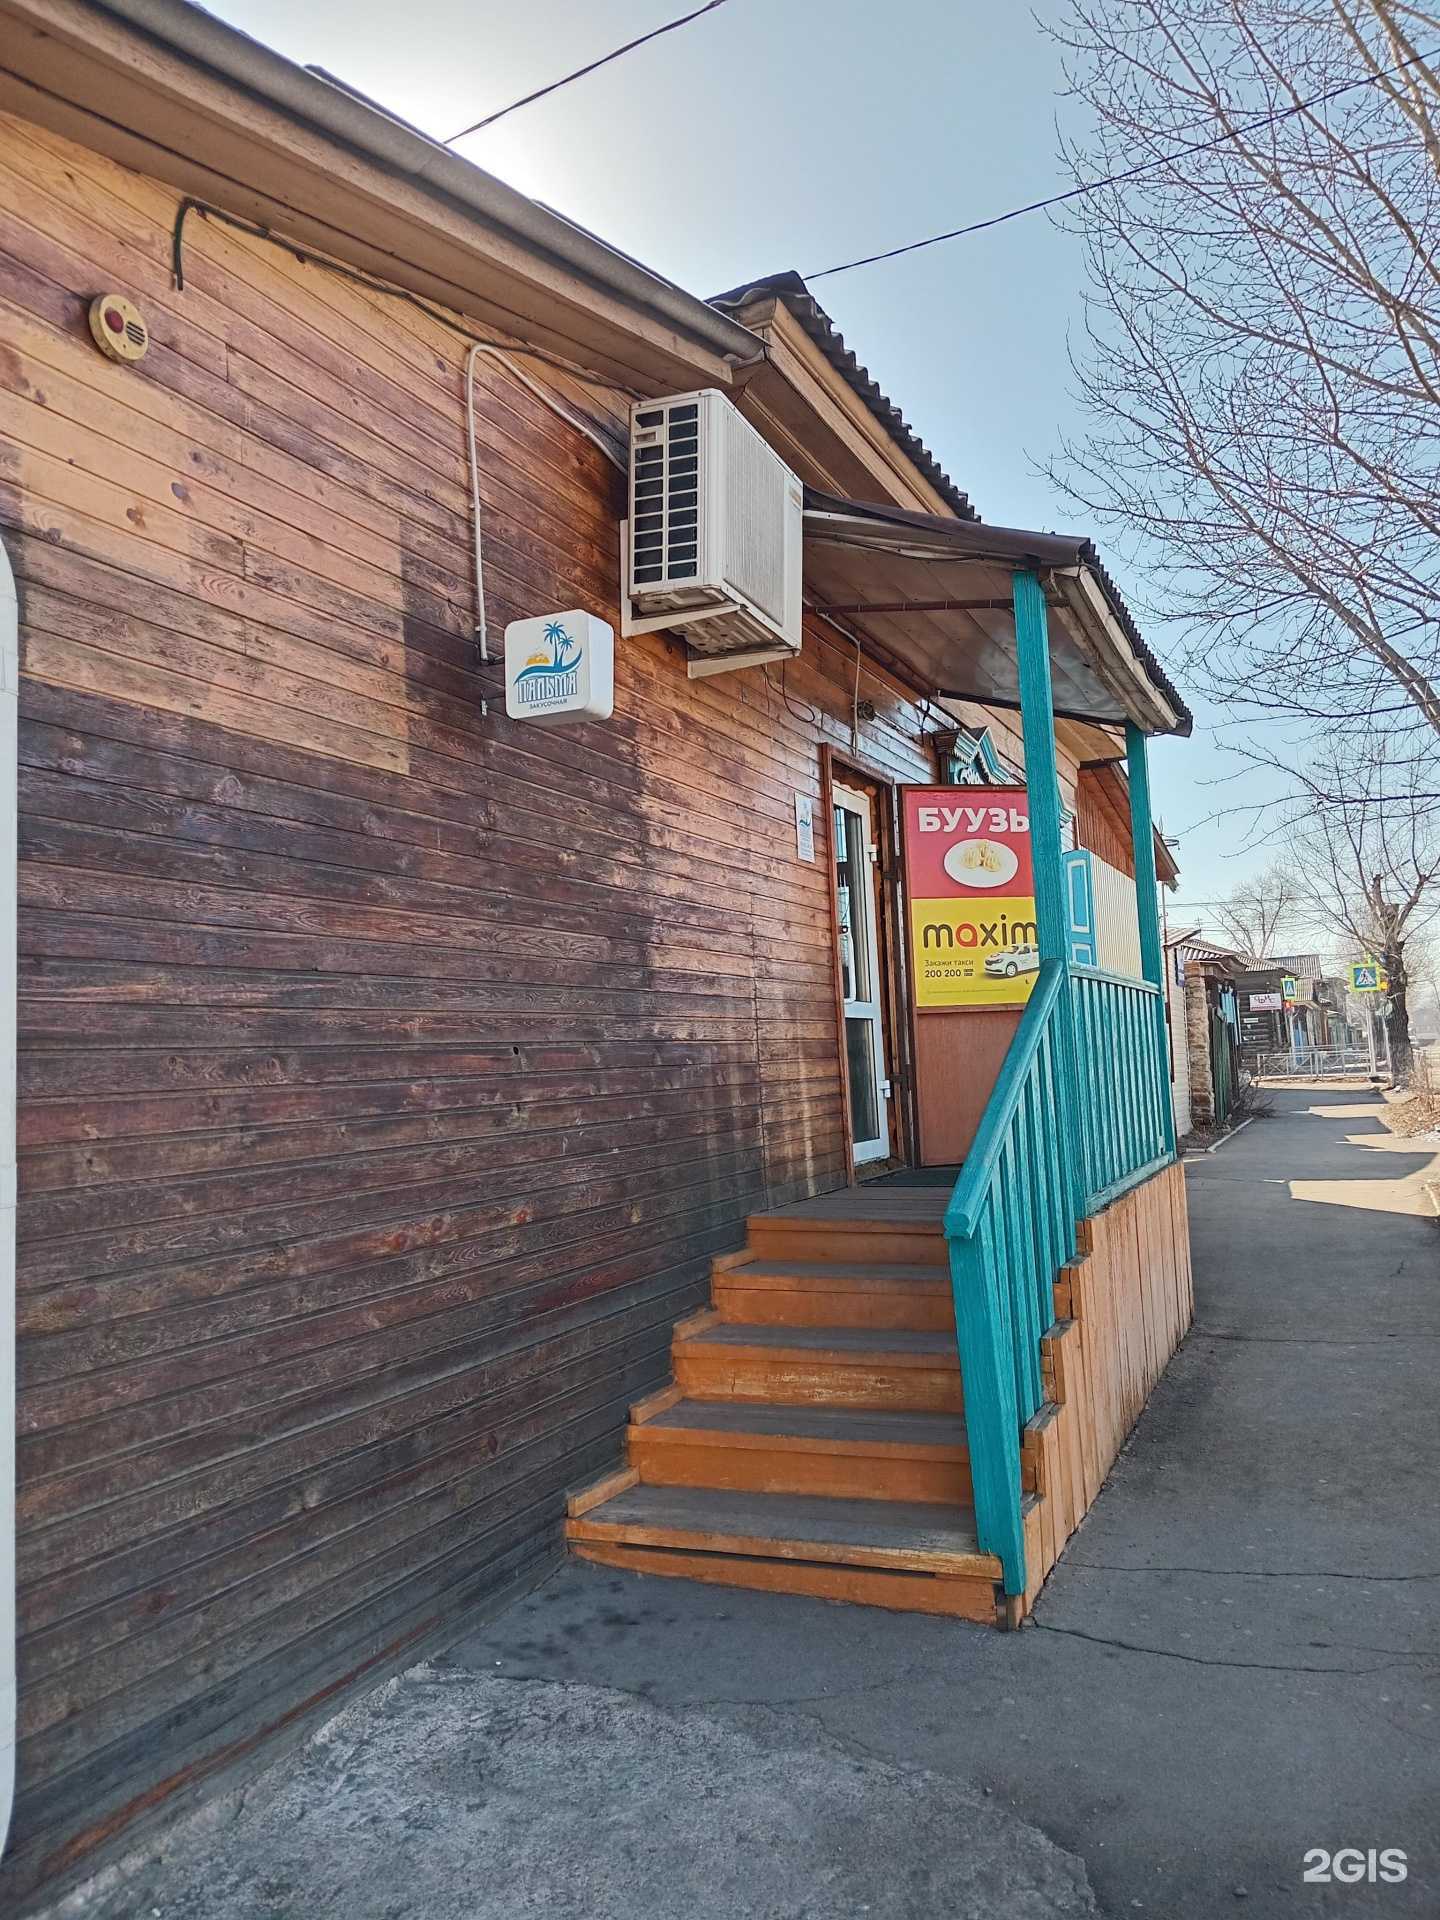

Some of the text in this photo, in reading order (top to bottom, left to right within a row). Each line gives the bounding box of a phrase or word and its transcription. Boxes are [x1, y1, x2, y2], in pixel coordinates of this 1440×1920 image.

[518, 672, 577, 704] ПАЛЬМА
[923, 914, 1037, 948] maxim
[924, 959, 974, 967] Закажи такси
[924, 969, 942, 978] 200
[944, 968, 962, 977] 200
